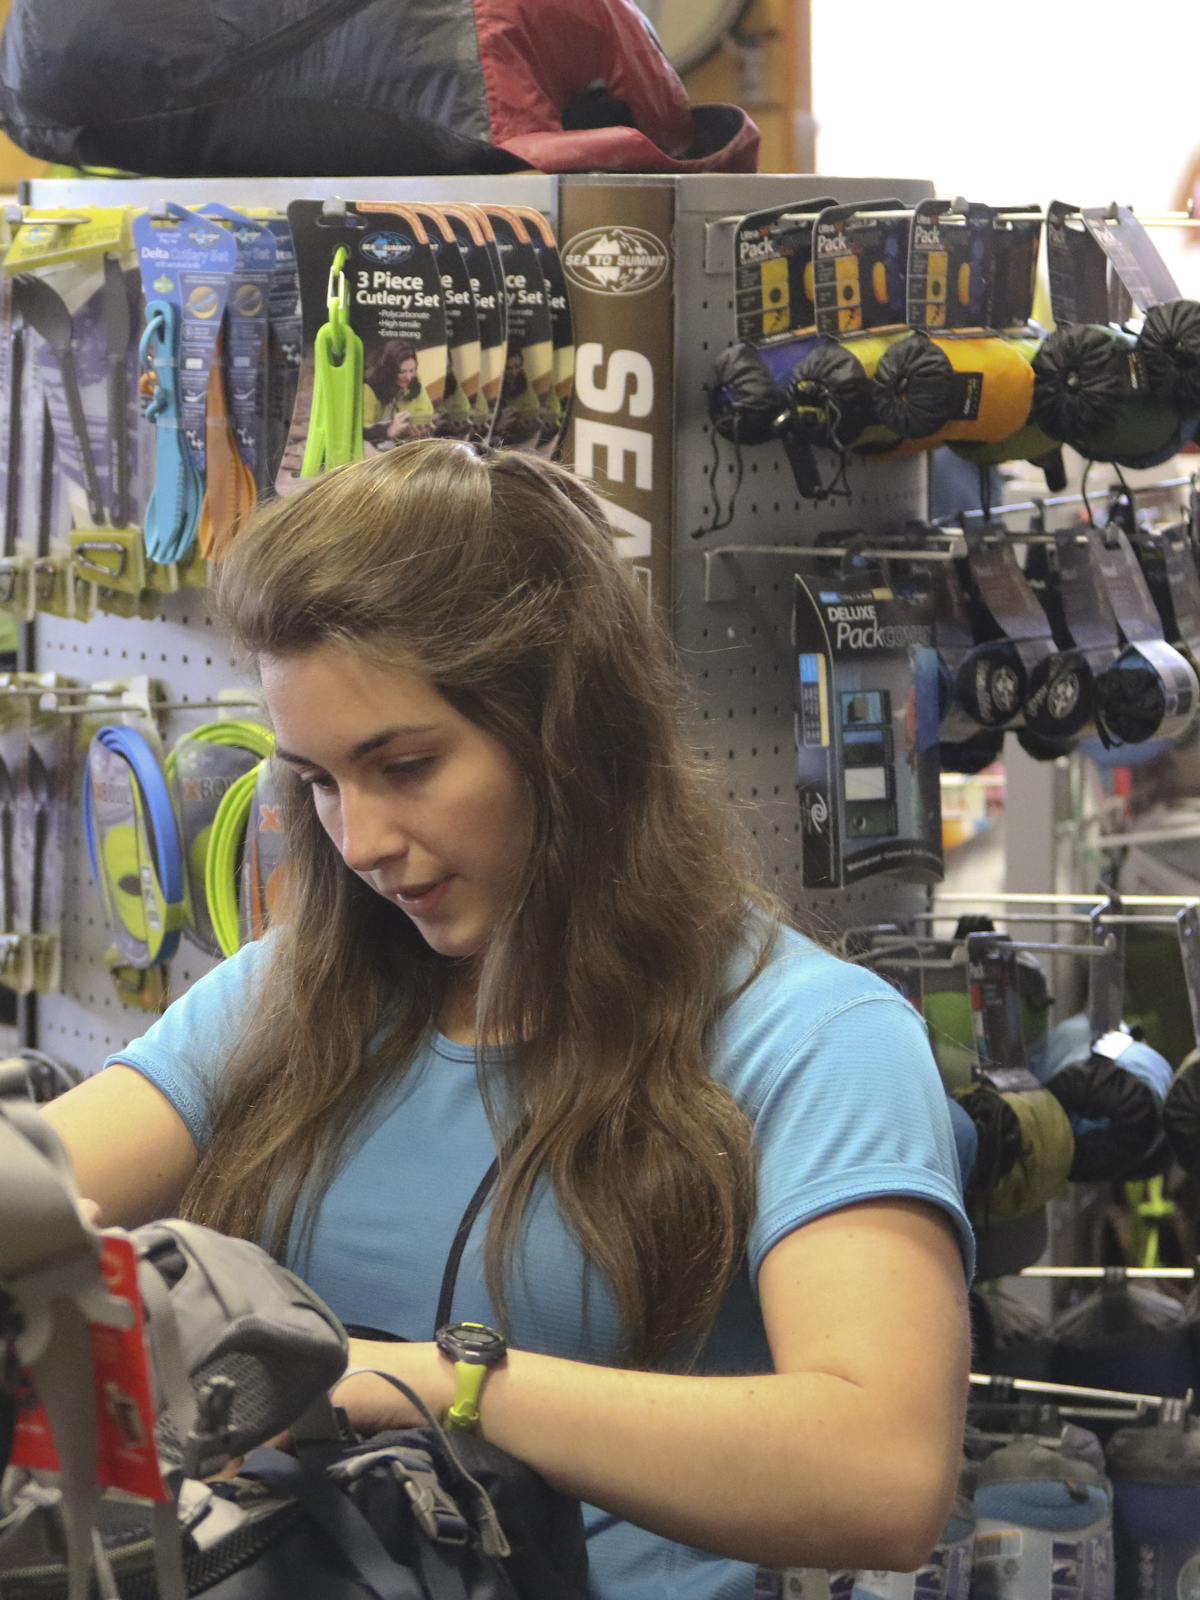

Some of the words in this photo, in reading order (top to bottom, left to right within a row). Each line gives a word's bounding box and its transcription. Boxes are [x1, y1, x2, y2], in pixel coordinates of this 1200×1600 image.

[914, 225, 941, 244] Pack
[361, 243, 376, 251] SEA
[382, 244, 412, 252] SUMMIT
[739, 236, 775, 260] Pack
[817, 232, 848, 254] Pack
[141, 246, 169, 260] Delta
[564, 254, 591, 266] SEA
[594, 254, 614, 266] TO
[617, 254, 666, 267] SUMMIT
[356, 271, 370, 288] 3
[373, 271, 424, 291] Piece
[356, 289, 413, 309] Cutlery
[414, 291, 441, 308] Set
[445, 289, 471, 305] Set
[518, 289, 544, 305] Set
[381, 309, 430, 320] Polycarbonate
[381, 319, 398, 329] High
[381, 328, 398, 337] Extra
[398, 329, 422, 339] strong
[827, 605, 877, 623] DELUXE
